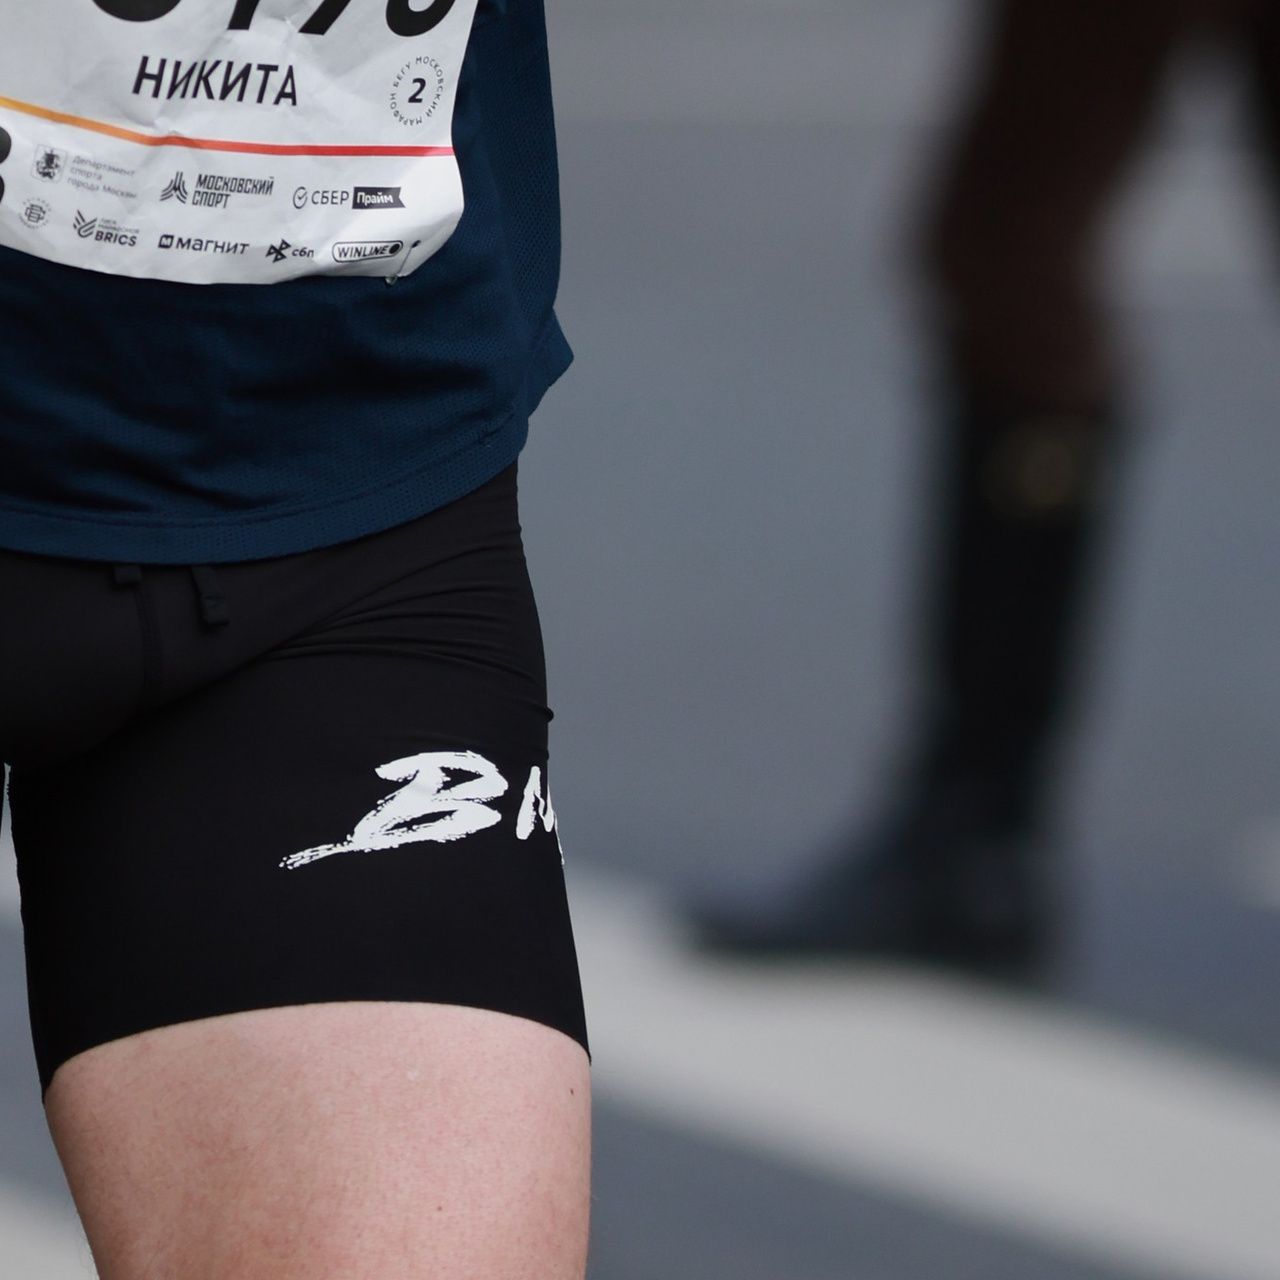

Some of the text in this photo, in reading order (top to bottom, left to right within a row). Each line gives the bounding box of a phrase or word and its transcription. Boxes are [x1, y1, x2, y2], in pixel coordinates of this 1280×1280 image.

[132, 55, 298, 107] НИКИТА
[407, 77, 427, 104] 2
[195, 173, 275, 197] МОСКОВСКИЙ
[192, 191, 232, 209] СПОРТ
[311, 189, 394, 206] СБЕР Прайм
[94, 230, 138, 248] BRICS
[175, 236, 250, 255] магнит
[291, 247, 315, 259] сбп
[337, 244, 390, 259] WINLINE
